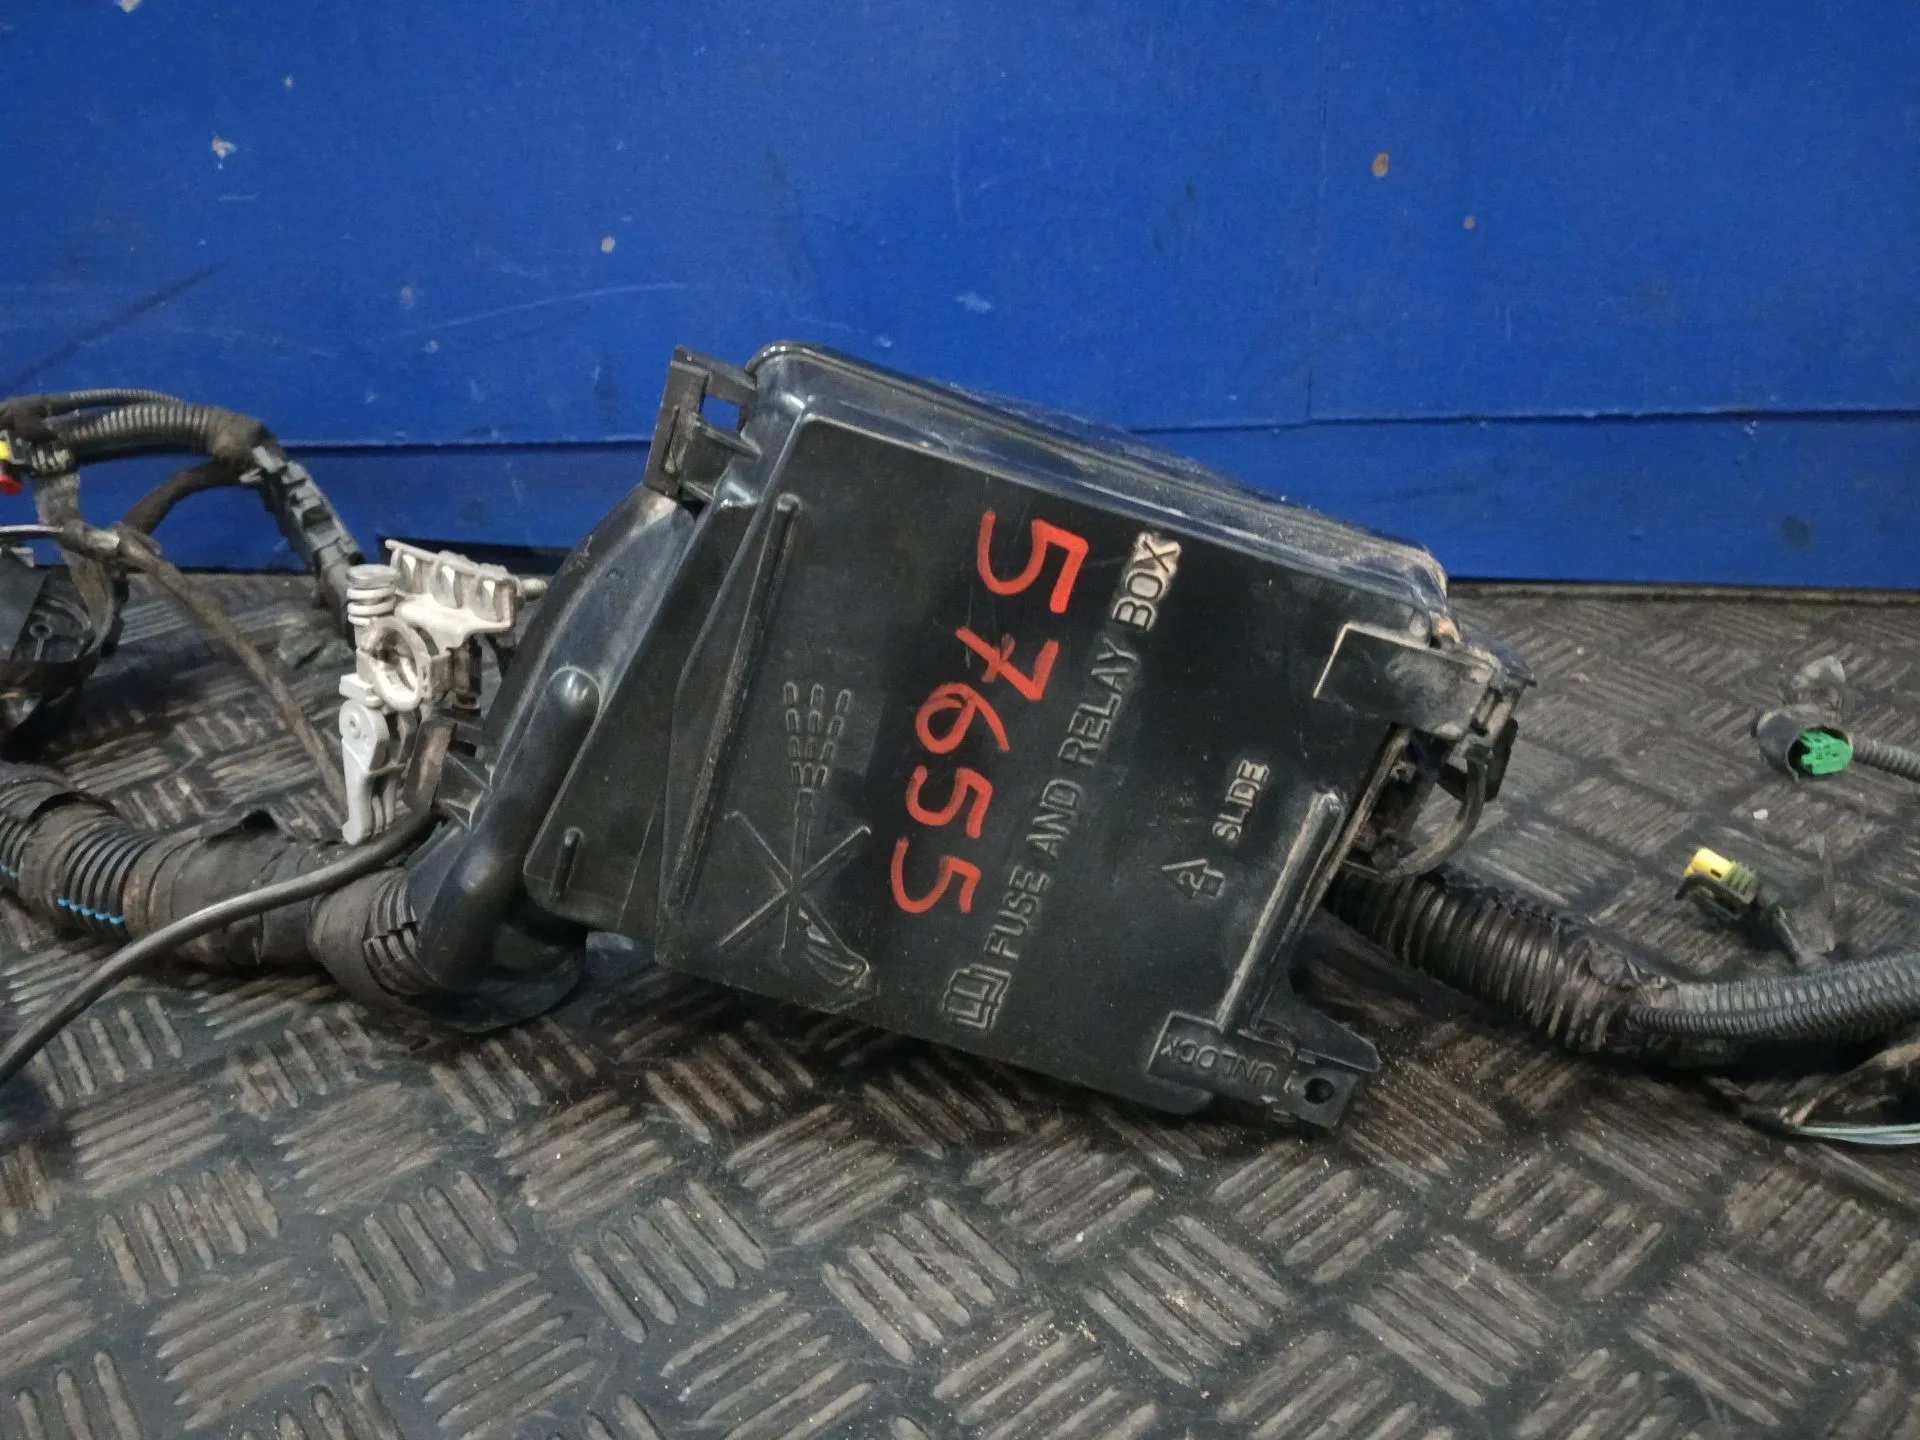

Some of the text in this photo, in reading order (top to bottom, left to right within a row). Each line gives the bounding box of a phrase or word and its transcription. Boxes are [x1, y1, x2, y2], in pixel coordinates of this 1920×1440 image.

[891, 509, 1088, 914] 57655
[983, 532, 1182, 961] FUSE AND RELAY BOX
[1212, 759, 1270, 842] SLIDE
[1160, 1036, 1278, 1088] UNLOCK
